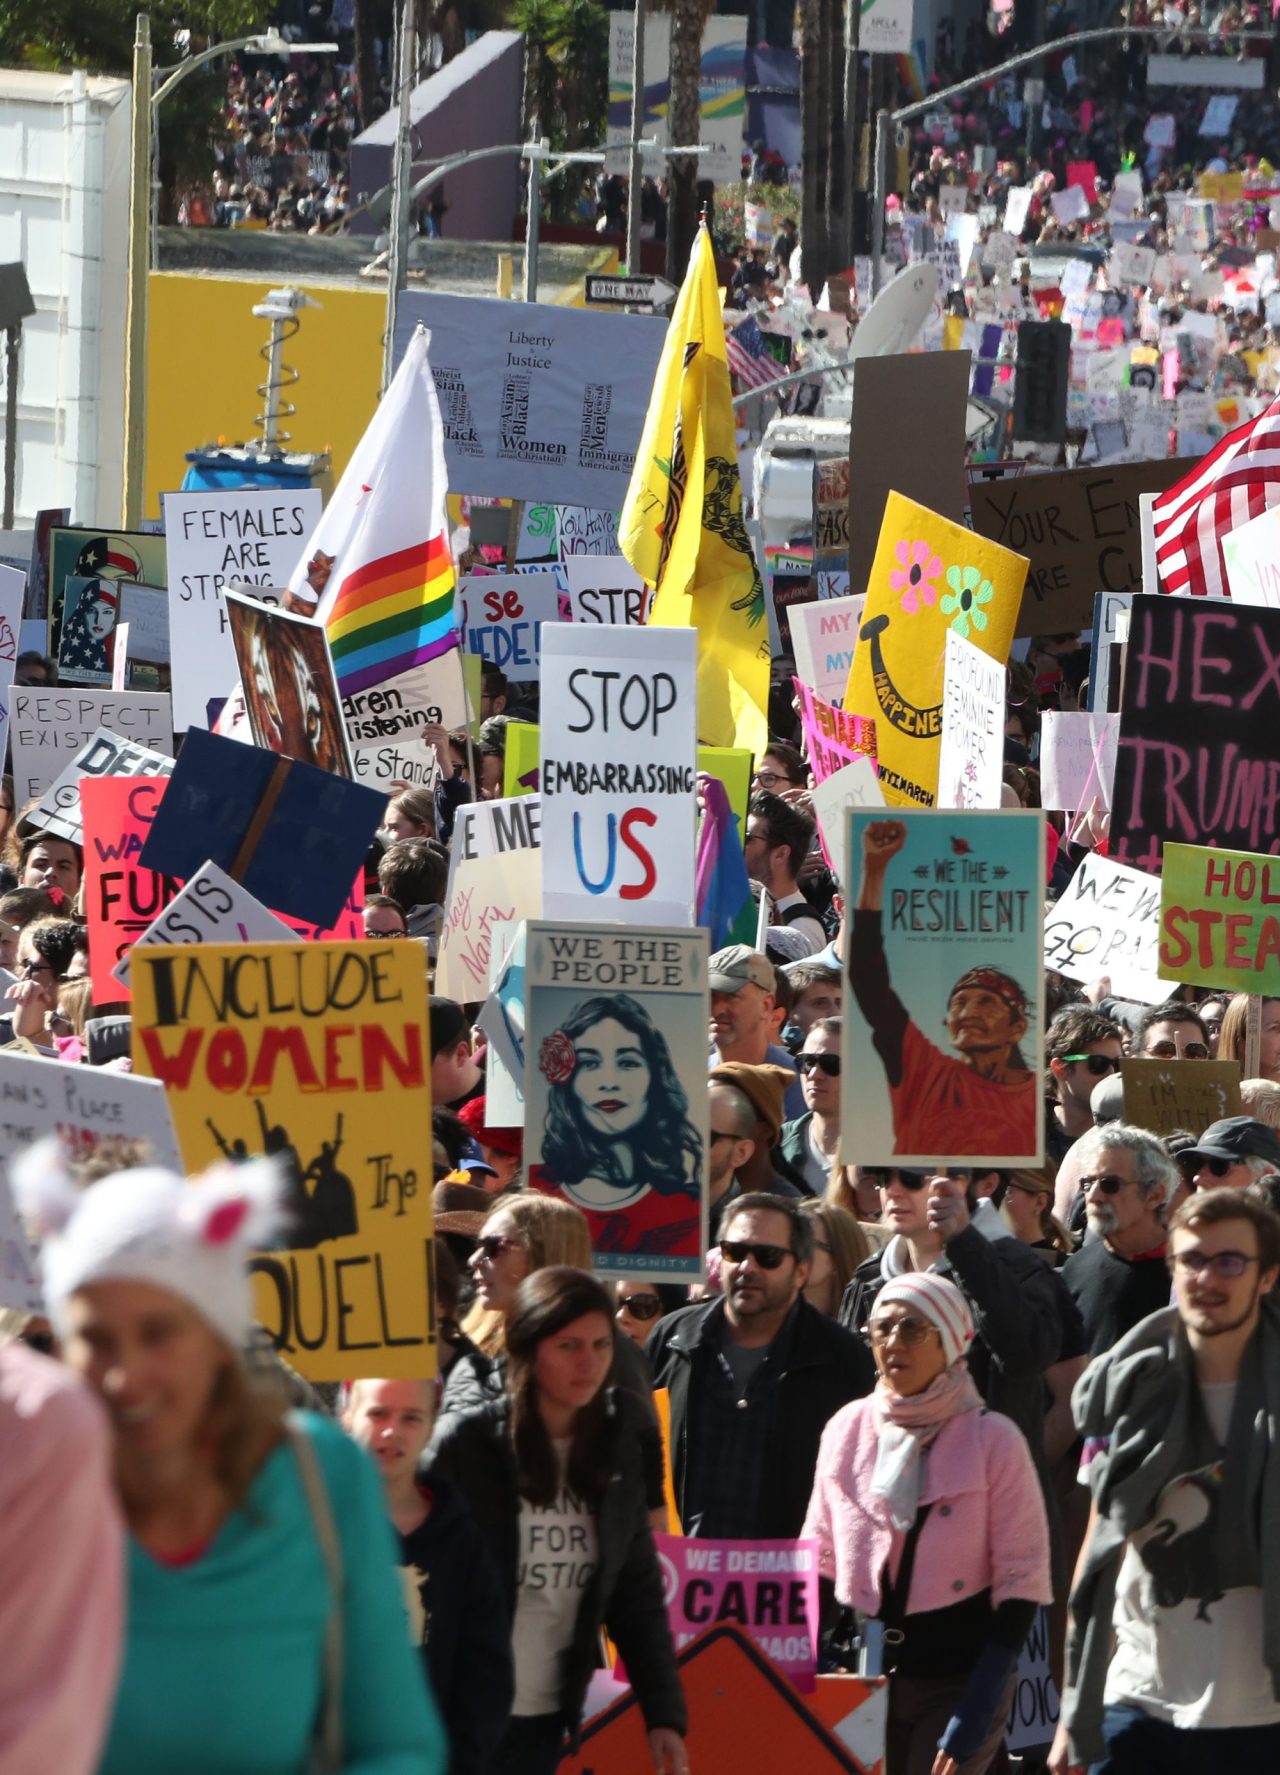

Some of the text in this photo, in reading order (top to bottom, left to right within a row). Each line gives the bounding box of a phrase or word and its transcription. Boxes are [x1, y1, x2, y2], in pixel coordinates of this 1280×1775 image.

[594, 284, 651, 299] ONE WAY
[508, 330, 556, 351] Liberty
[506, 351, 552, 370] Justice
[434, 378, 466, 392] sian
[502, 383, 516, 422] Asian
[512, 391, 530, 437] Black
[501, 434, 567, 455] Women
[590, 414, 608, 451] Men
[576, 460, 621, 473] American
[182, 506, 305, 541] FEMALES
[556, 506, 584, 536] You
[585, 507, 615, 537] Have
[985, 490, 1080, 550] YOUR
[221, 542, 272, 572] ARE
[484, 590, 525, 622] se
[820, 612, 853, 636] MY
[950, 640, 1002, 706] PROFOUND
[16, 696, 160, 728] RESPECT
[567, 668, 678, 737] STOP
[947, 678, 995, 736] FEMININE
[19, 730, 164, 749] EXISTCE
[948, 713, 987, 768] POWER
[376, 748, 437, 788] Stand
[542, 759, 694, 796] EMBARRASSING
[572, 807, 659, 901] US
[934, 858, 989, 884] WE THE
[1076, 862, 1136, 912] WE
[891, 888, 1030, 933] RESILIENT
[548, 936, 683, 964] WE THE
[143, 947, 403, 1028] INCLUDE
[551, 960, 684, 987] PEOPLE
[138, 1022, 426, 1097] WOMEN
[63, 1075, 124, 1123] PLACE
[2, 1122, 37, 1144] THE
[367, 1153, 418, 1217] The
[616, 1256, 690, 1268] DIGNITY
[528, 1525, 589, 1553] FOR
[686, 1548, 722, 1572] WE
[682, 1577, 808, 1627] CARE
